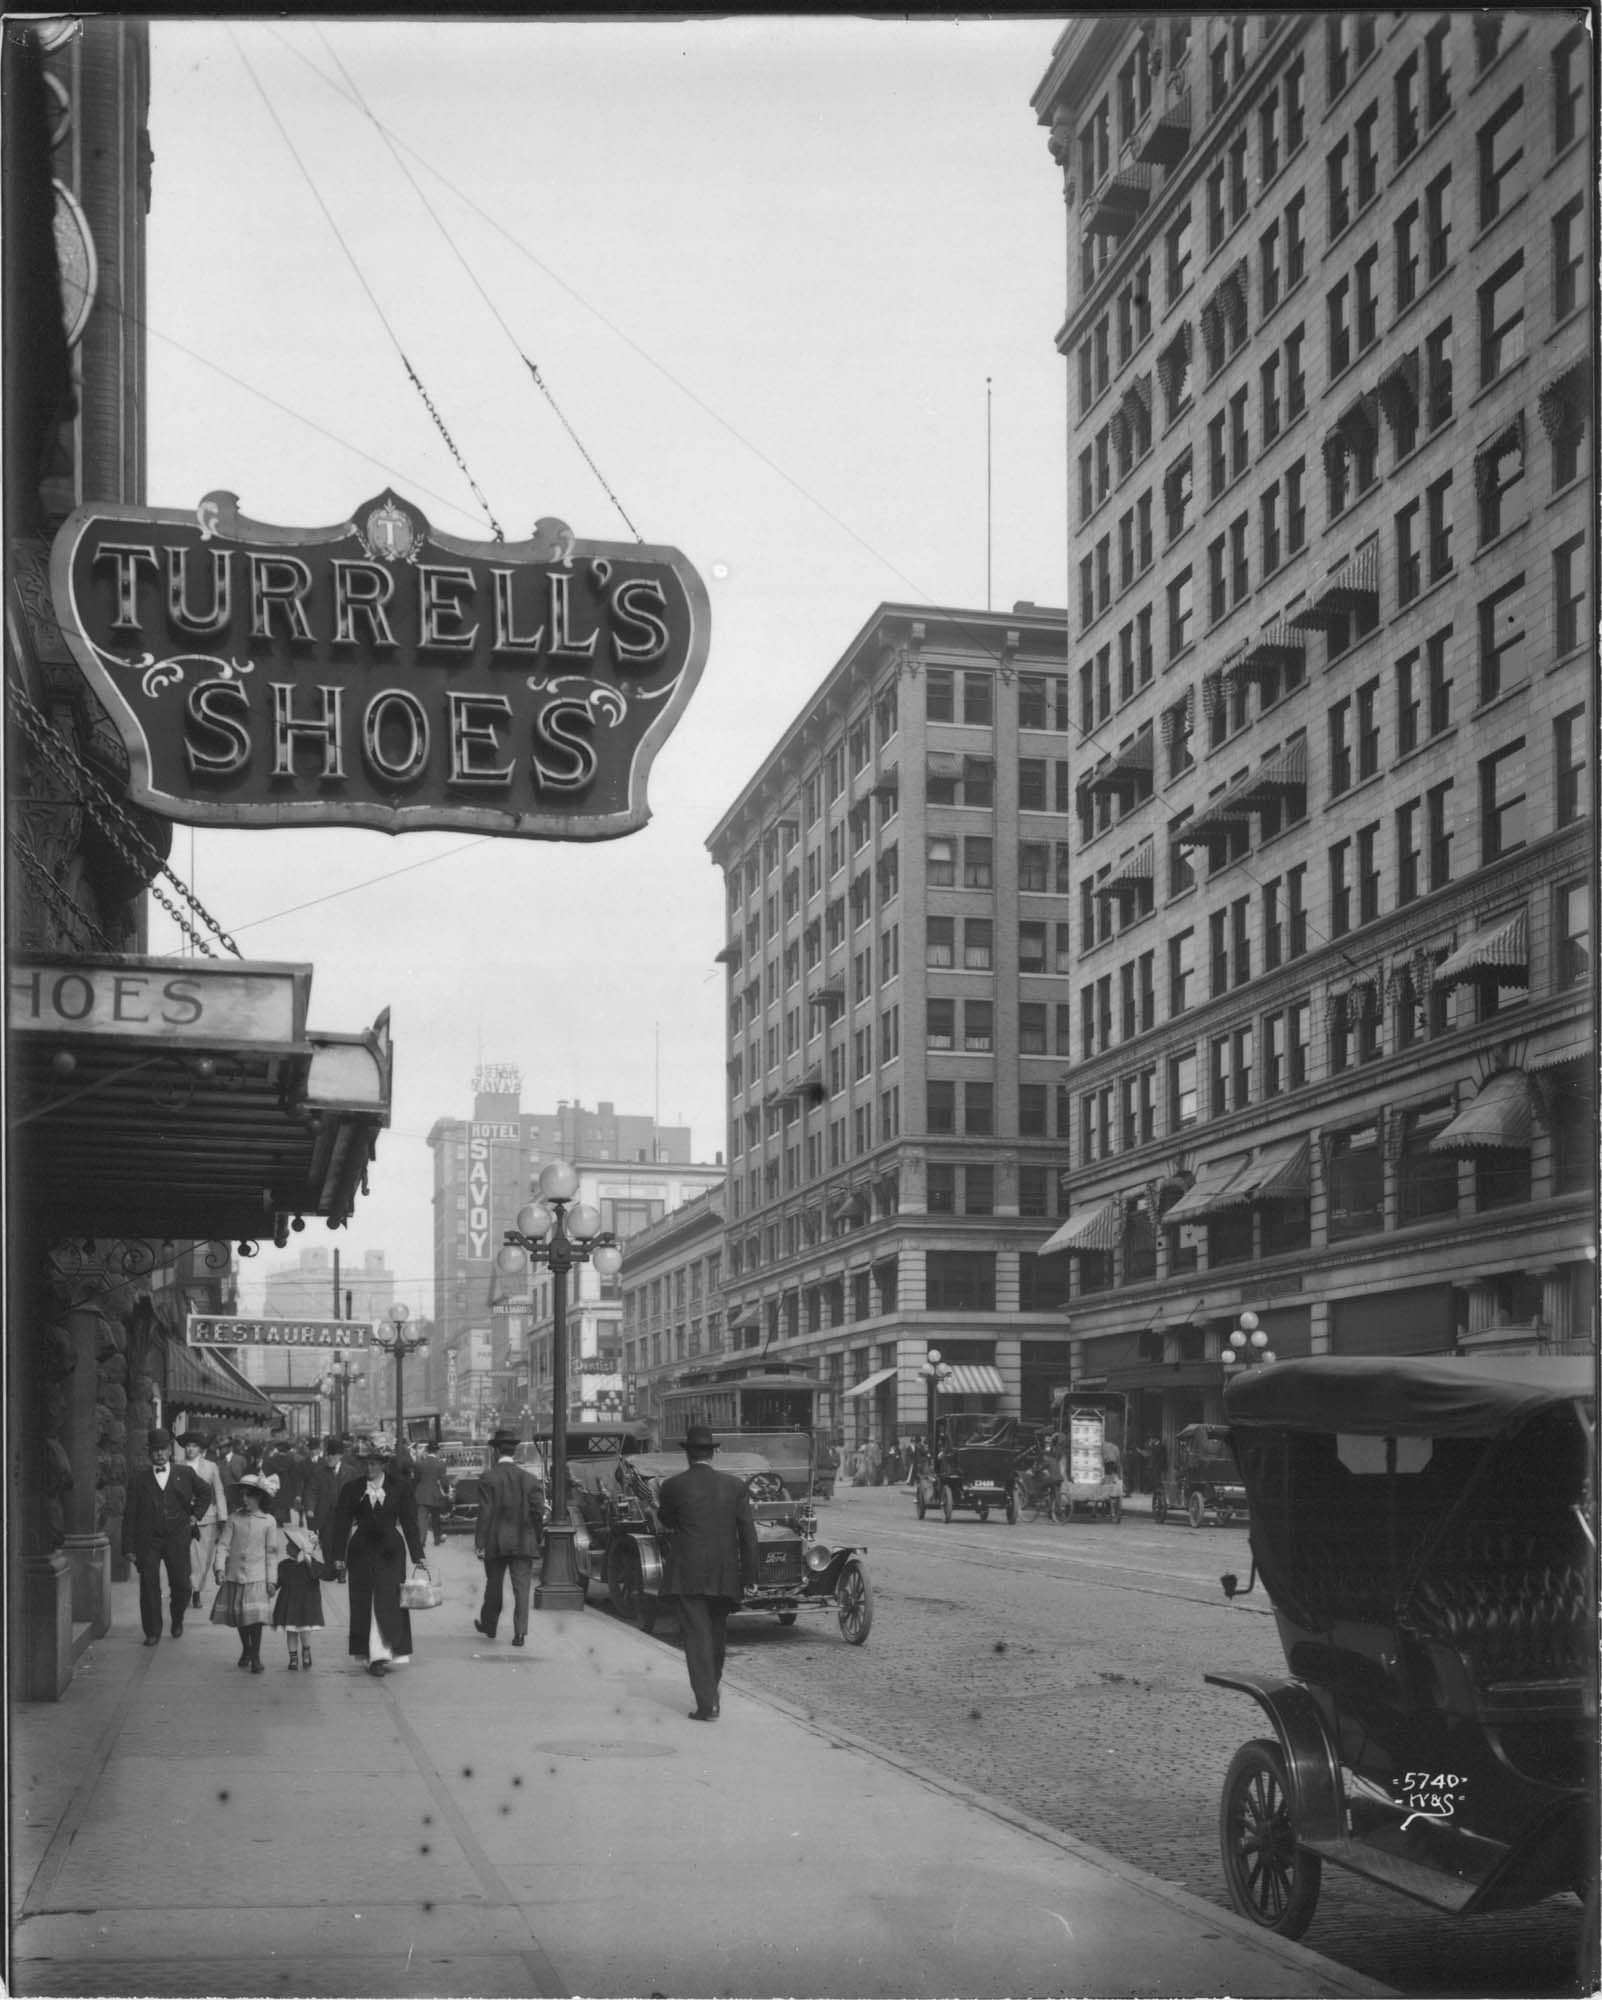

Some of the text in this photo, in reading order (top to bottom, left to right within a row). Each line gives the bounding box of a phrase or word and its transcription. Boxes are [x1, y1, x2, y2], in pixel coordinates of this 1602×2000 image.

[92, 542, 670, 662] TURRELL'S
[183, 678, 600, 791] SHOES
[472, 1124, 518, 1138] HOTEL
[470, 1138, 489, 1258] SAVOY
[195, 1321, 367, 1346] RESTAURANT
